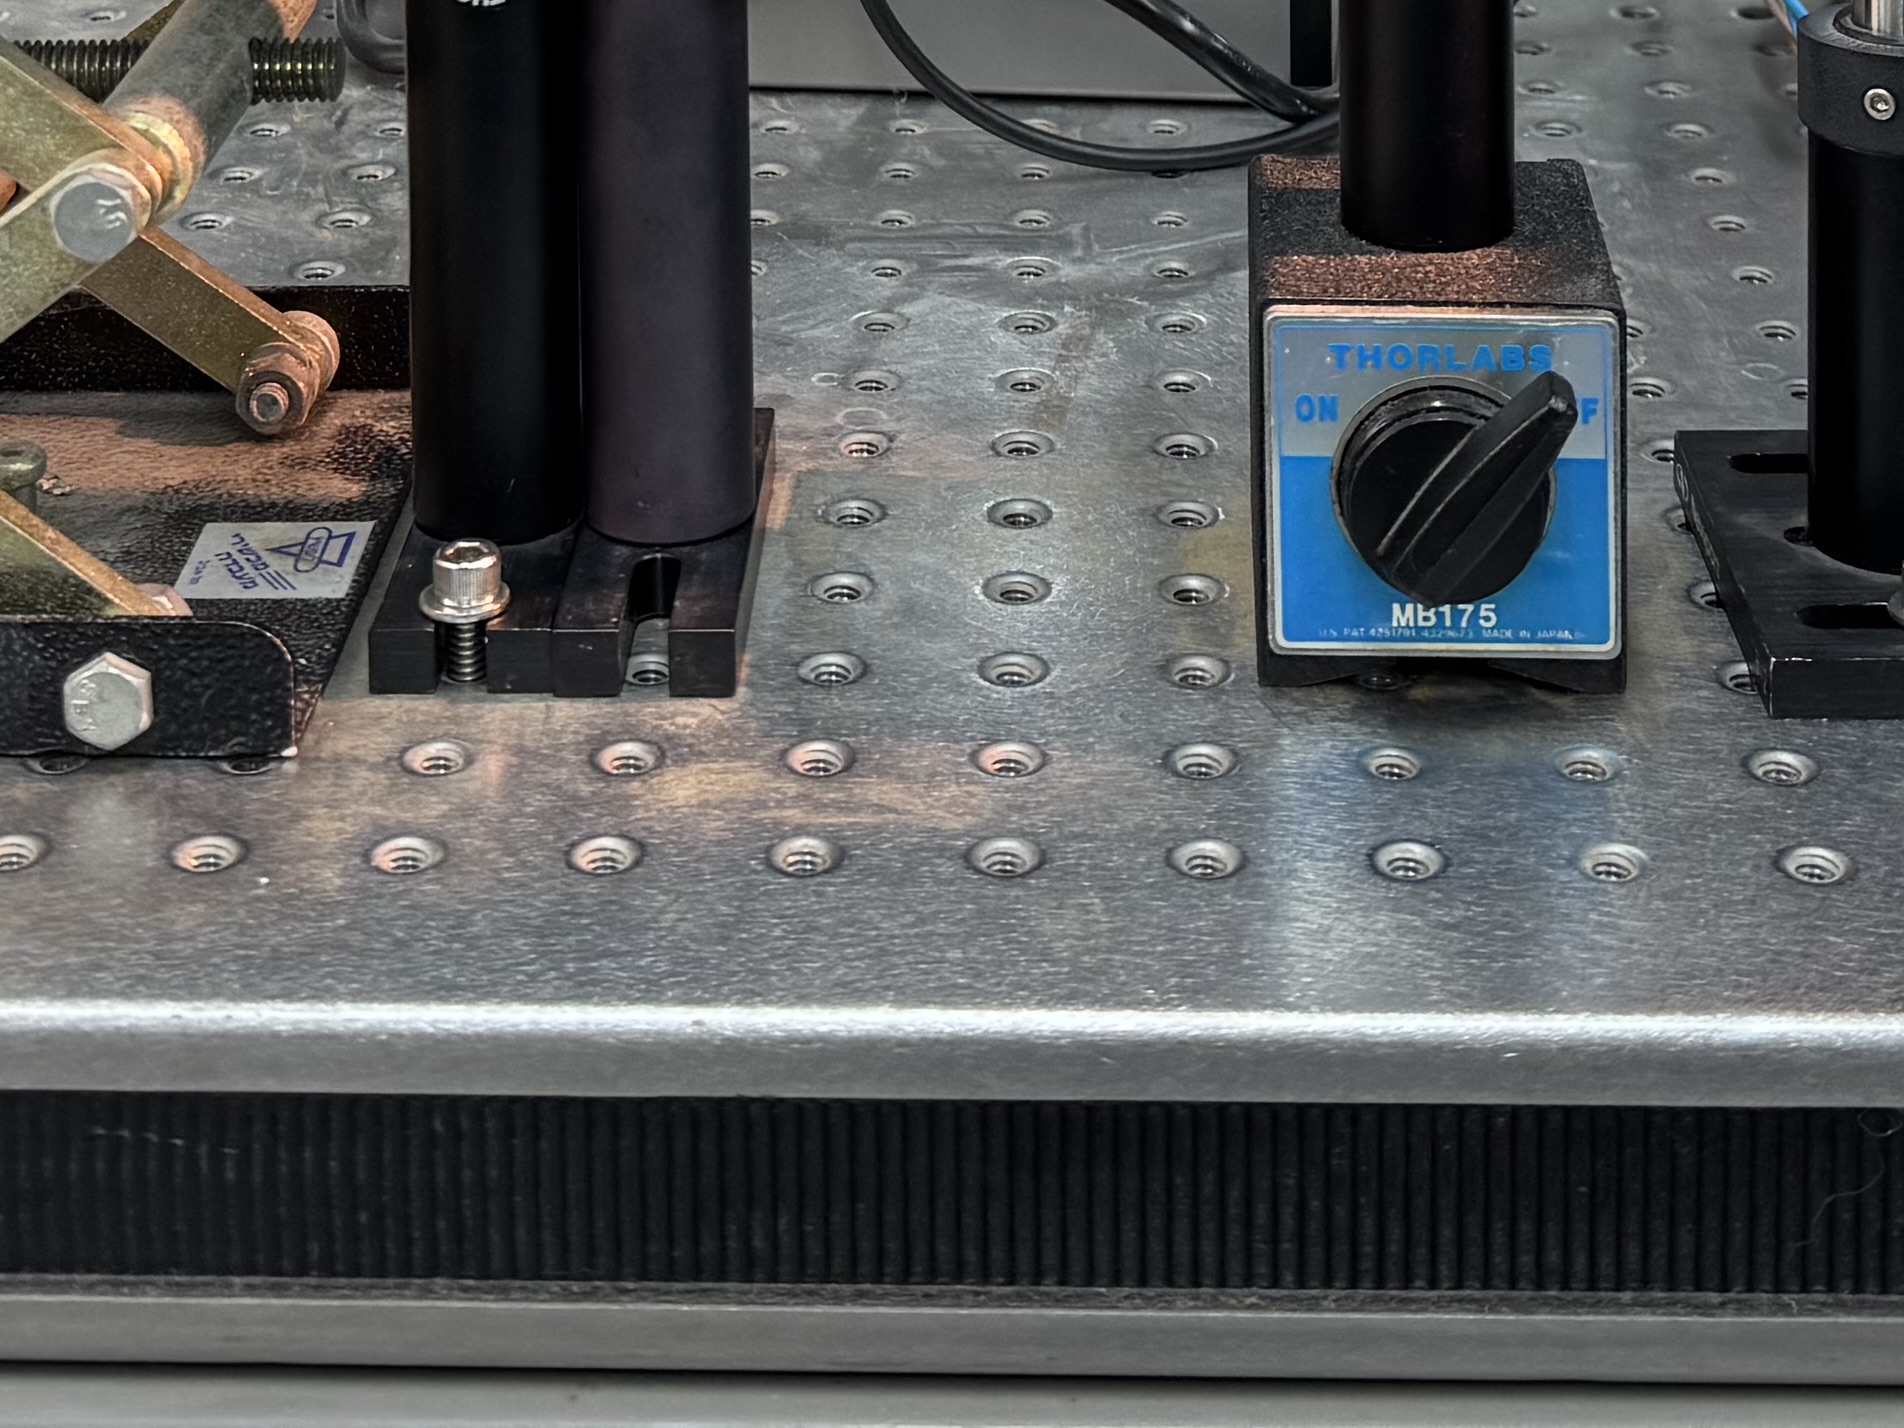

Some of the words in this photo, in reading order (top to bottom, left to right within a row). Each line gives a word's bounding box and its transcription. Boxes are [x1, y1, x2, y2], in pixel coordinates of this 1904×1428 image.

[1328, 343, 1553, 373] THORLABS
[1295, 393, 1339, 424] ON
[1392, 602, 1498, 628] MB175
